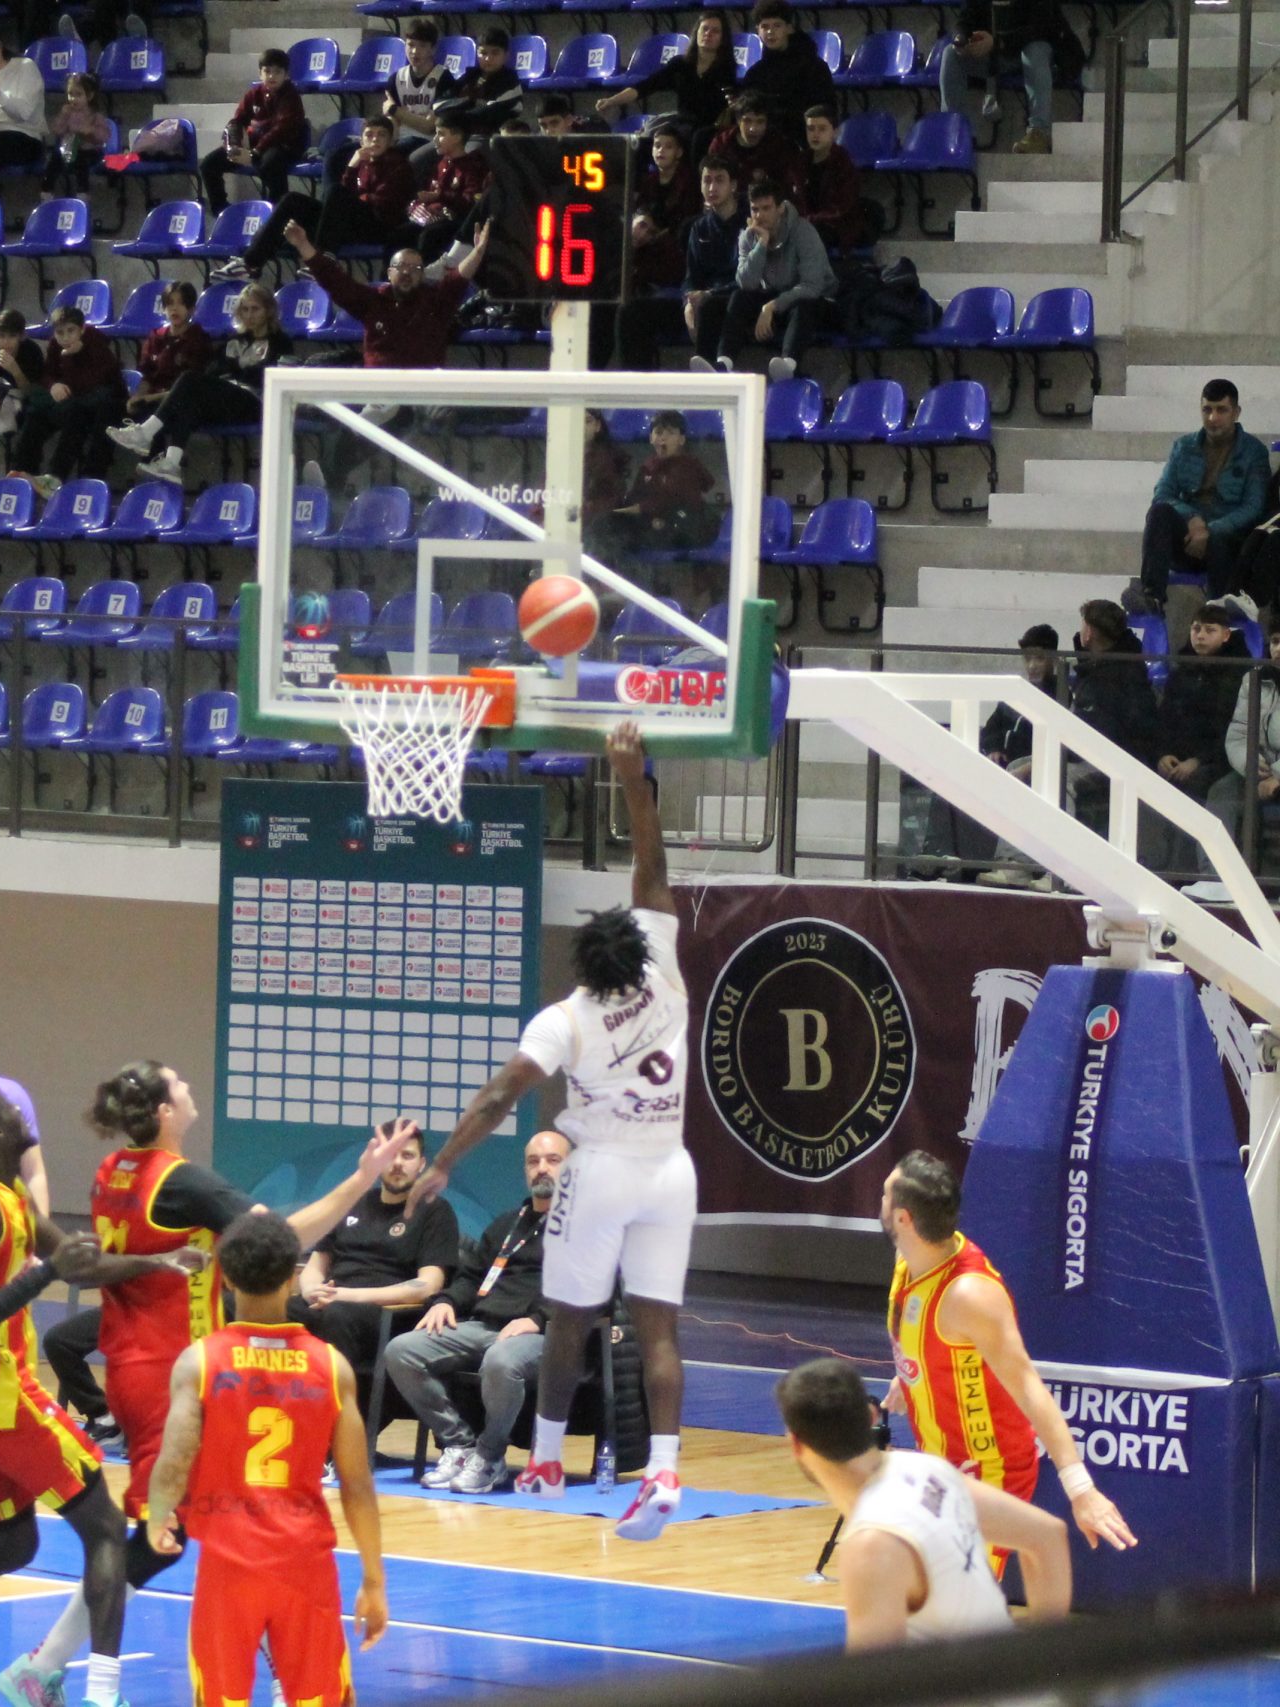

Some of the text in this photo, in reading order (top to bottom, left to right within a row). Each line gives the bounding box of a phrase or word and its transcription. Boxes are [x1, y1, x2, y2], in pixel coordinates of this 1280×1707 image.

[53, 54, 67, 68] 14
[132, 53, 146, 68] 15
[311, 54, 324, 68] 18
[376, 56, 390, 70] 19
[445, 56, 458, 70] 20
[517, 53, 530, 67] 21
[589, 51, 603, 65] 22
[563, 151, 604, 191] 45
[58, 213, 73, 227] 12
[170, 217, 185, 231] 15
[244, 219, 258, 233] 16
[535, 203, 595, 286] 16
[297, 301, 311, 316] 16
[2, 497, 14, 512] 8
[77, 497, 88, 512] 9
[147, 503, 161, 518] 10
[223, 503, 237, 518] 11
[297, 503, 312, 519] 12
[38, 593, 48, 607] 6
[112, 597, 123, 612] 7
[188, 600, 199, 615] 8
[656, 668, 726, 706] TBF
[55, 704, 66, 720] 9
[129, 706, 143, 723] 10
[212, 711, 226, 726] 11
[269, 824, 298, 833] TÜRKİYE
[374, 826, 404, 835] TÜRKİYE
[481, 829, 511, 838] TÜRKİYE
[268, 832, 309, 842] BASKETBOL
[373, 835, 415, 845] BASKETBOL
[481, 838, 524, 848] BASKETBOL
[784, 932, 828, 952] 2023
[778, 1008, 833, 1091] B
[638, 1049, 674, 1086] 0
[712, 983, 743, 1097] BORDO
[732, 1102, 870, 1170] BASKETBOL
[865, 982, 908, 1124] KULÜBÜ
[1064, 1044, 1108, 1291] TÜRKİYE SİGORTA
[232, 1345, 309, 1373] BARNES
[245, 1405, 294, 1488] 2
